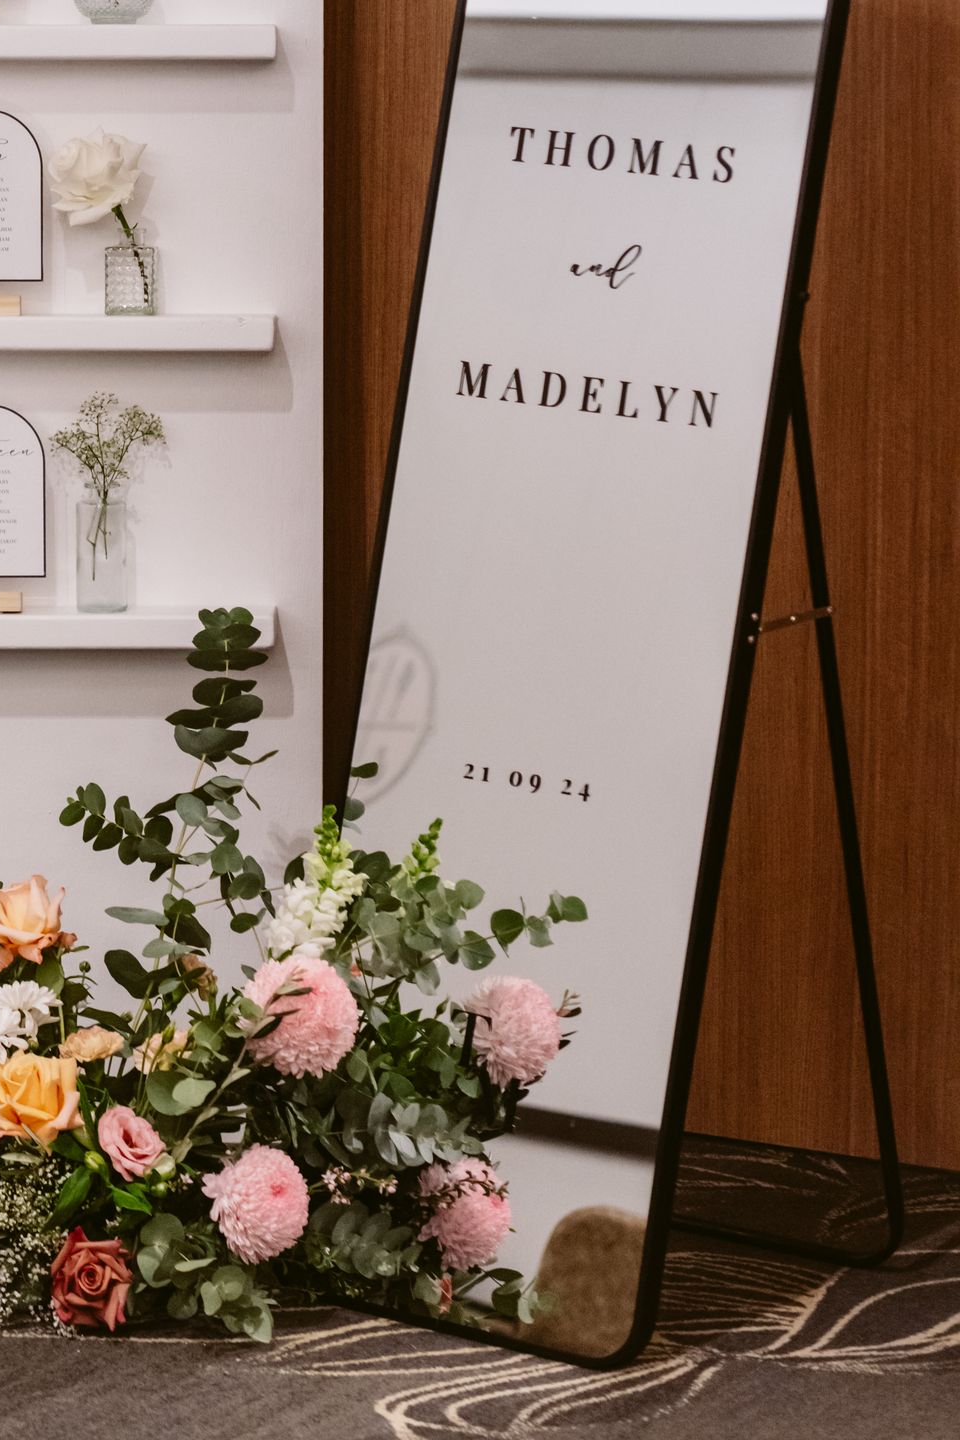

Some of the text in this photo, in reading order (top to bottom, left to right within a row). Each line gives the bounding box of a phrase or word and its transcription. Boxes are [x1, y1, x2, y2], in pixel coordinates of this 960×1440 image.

[510, 126, 736, 183] THOMAS
[569, 244, 642, 289] and
[456, 360, 719, 428] MADELYN
[463, 763, 590, 802] 21 09 24
